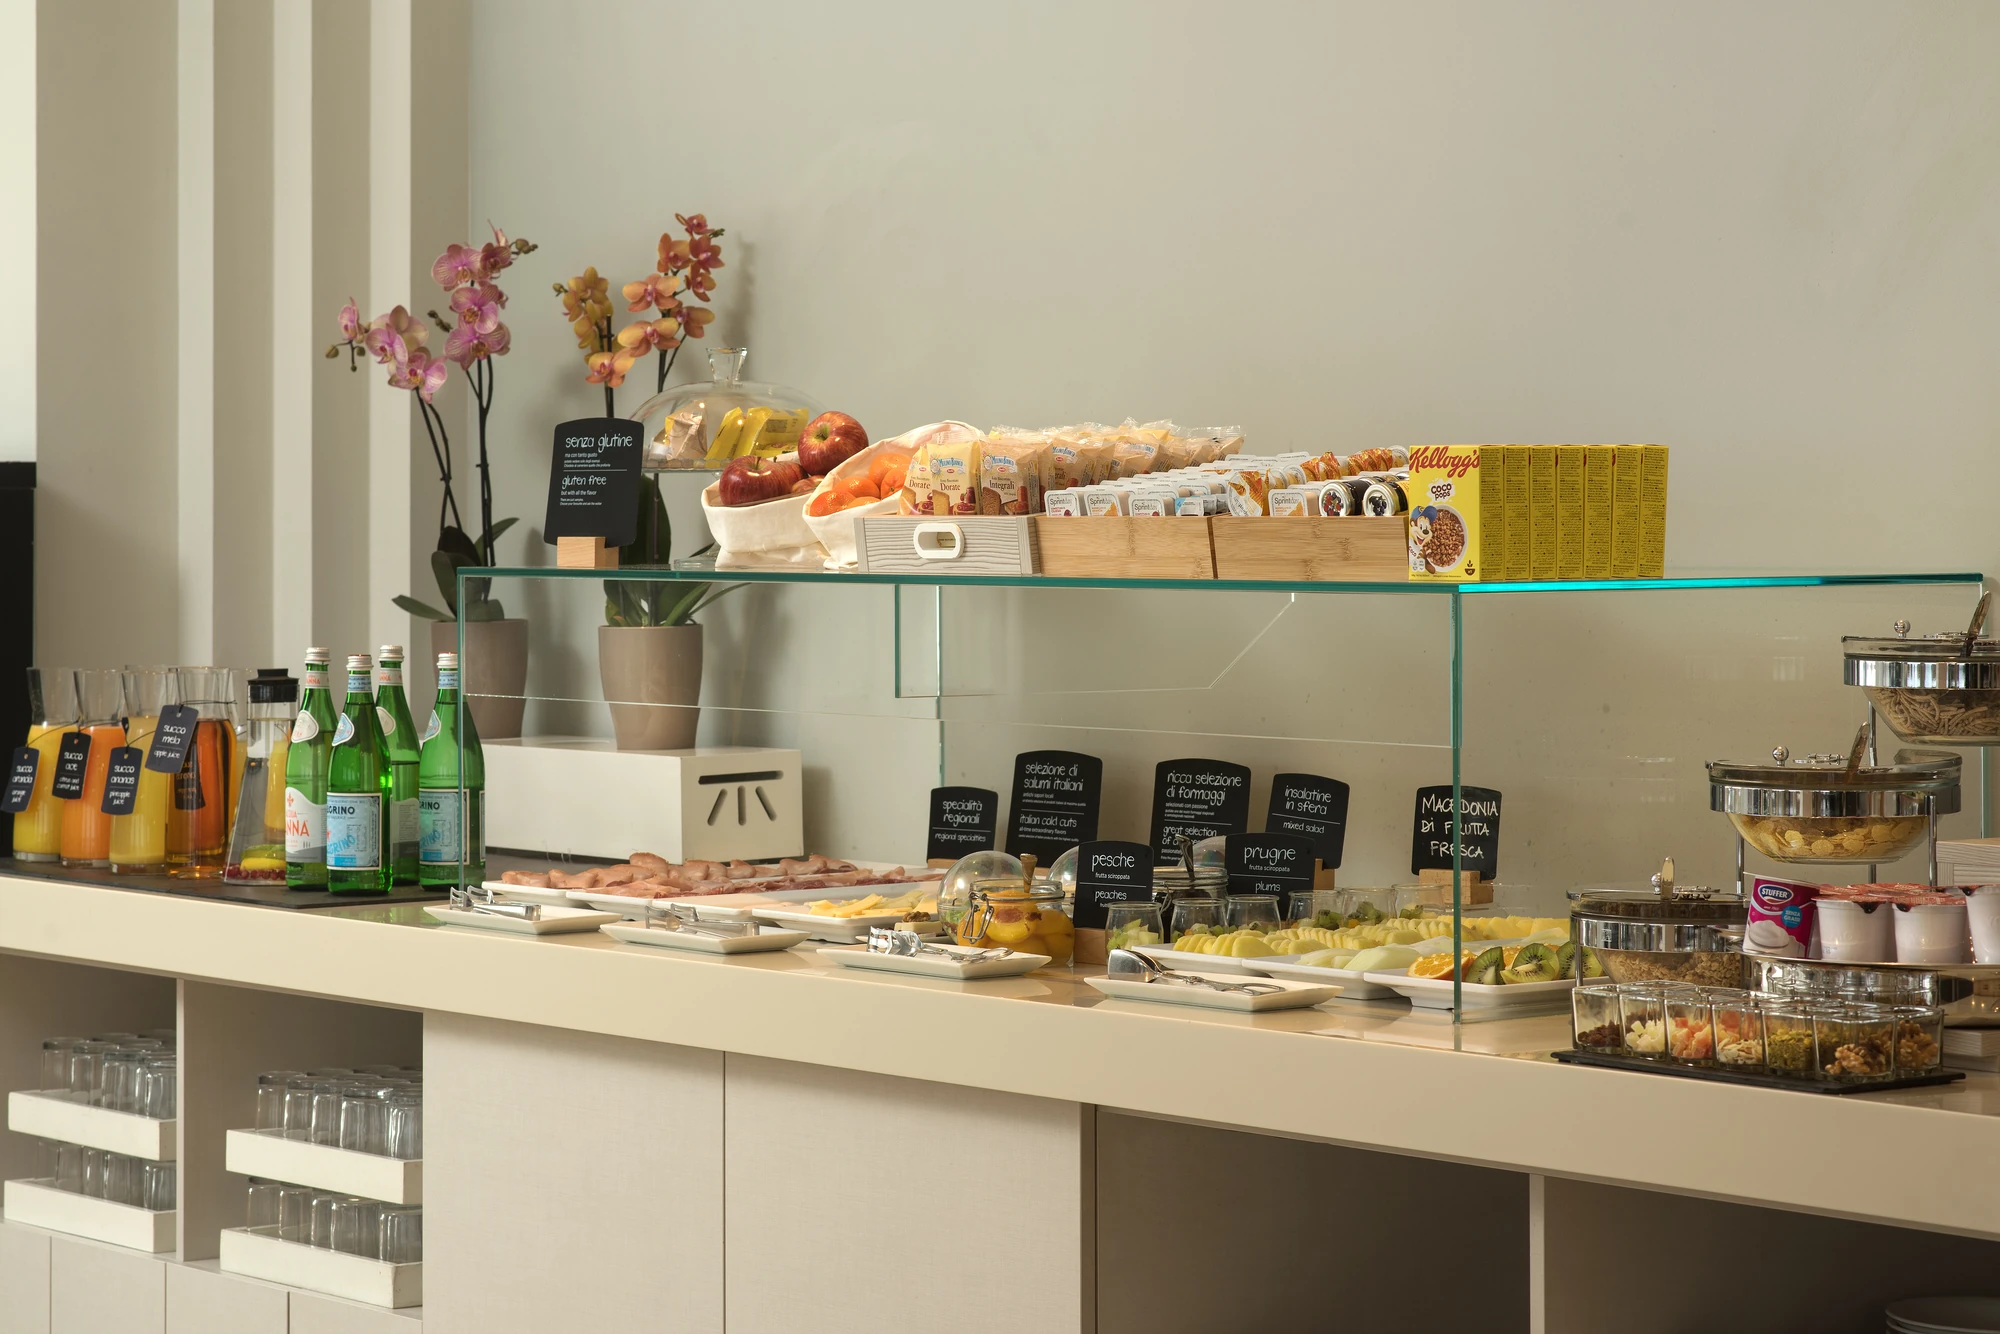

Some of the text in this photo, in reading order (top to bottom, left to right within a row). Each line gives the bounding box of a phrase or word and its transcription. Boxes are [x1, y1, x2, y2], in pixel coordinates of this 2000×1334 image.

[566, 432, 632, 452] senza glutine
[1408, 446, 1480, 478] Kellogg's
[562, 474, 606, 490] gluten free
[909, 480, 931, 490] Dorate
[940, 483, 960, 491] Dorate
[990, 480, 1015, 492] Integrali
[1430, 483, 1452, 494] COCO
[1434, 490, 1451, 501] pops
[164, 724, 186, 734] succo
[162, 735, 181, 745] mela
[64, 751, 84, 760] succo
[16, 765, 33, 773] succo
[65, 763, 78, 771] ace
[114, 765, 135, 773] succo
[1026, 762, 1078, 776] selezione di
[12, 775, 33, 783] arancia
[110, 776, 135, 784] ananas
[1024, 776, 1084, 791] salumi italiani
[1167, 770, 1242, 787] ricca selezione
[1166, 785, 1226, 806] di formaggi
[1285, 785, 1332, 802] insalatine
[943, 800, 982, 813] specialità
[1286, 798, 1327, 815] in sfera
[1422, 794, 1498, 816] MACEDONIA
[943, 812, 980, 827] regionali
[1020, 814, 1077, 828] italian cold cuts
[1163, 826, 1217, 837] great selection
[1283, 821, 1324, 833] mixed salad
[1444, 821, 1489, 836] FRUTTA
[935, 832, 956, 842] regional
[1162, 836, 1172, 845] of
[1244, 846, 1296, 866] prugne
[1430, 841, 1484, 859] FRESCA
[1092, 852, 1135, 872] pesche
[1255, 881, 1280, 894] plums
[1762, 888, 1788, 898] STUFFER
[1094, 890, 1127, 902] peaches
